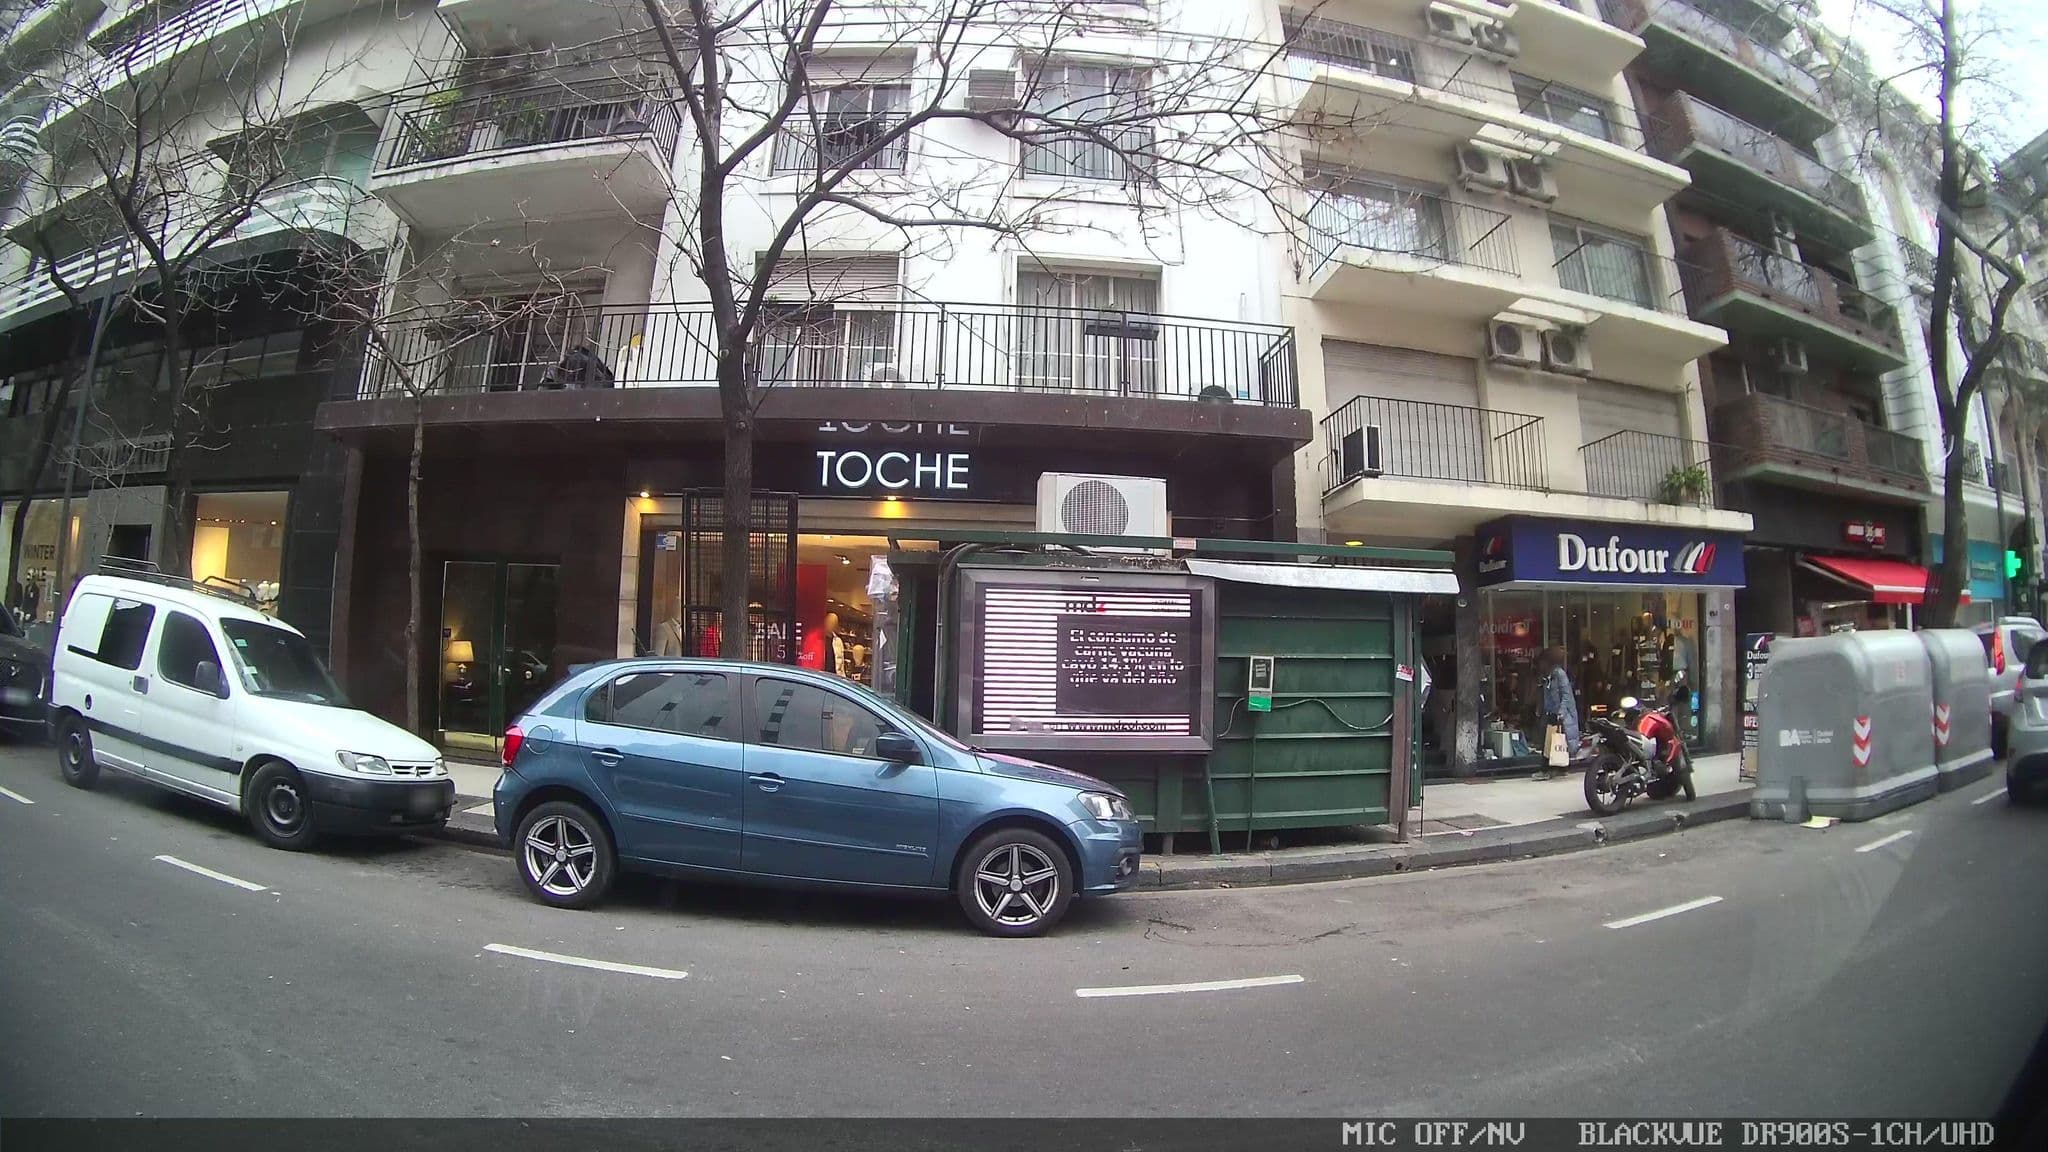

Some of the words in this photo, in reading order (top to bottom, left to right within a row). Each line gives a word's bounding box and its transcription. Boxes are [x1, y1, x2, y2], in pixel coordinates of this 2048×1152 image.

[817, 450, 970, 489] TOCHE
[23, 544, 56, 560] WINTER
[1558, 533, 1669, 574] Dufour
[1087, 632, 1156, 643] consumo
[1158, 631, 1177, 643] de
[1120, 646, 1172, 657] vacuna
[1746, 662, 1753, 679] 3
